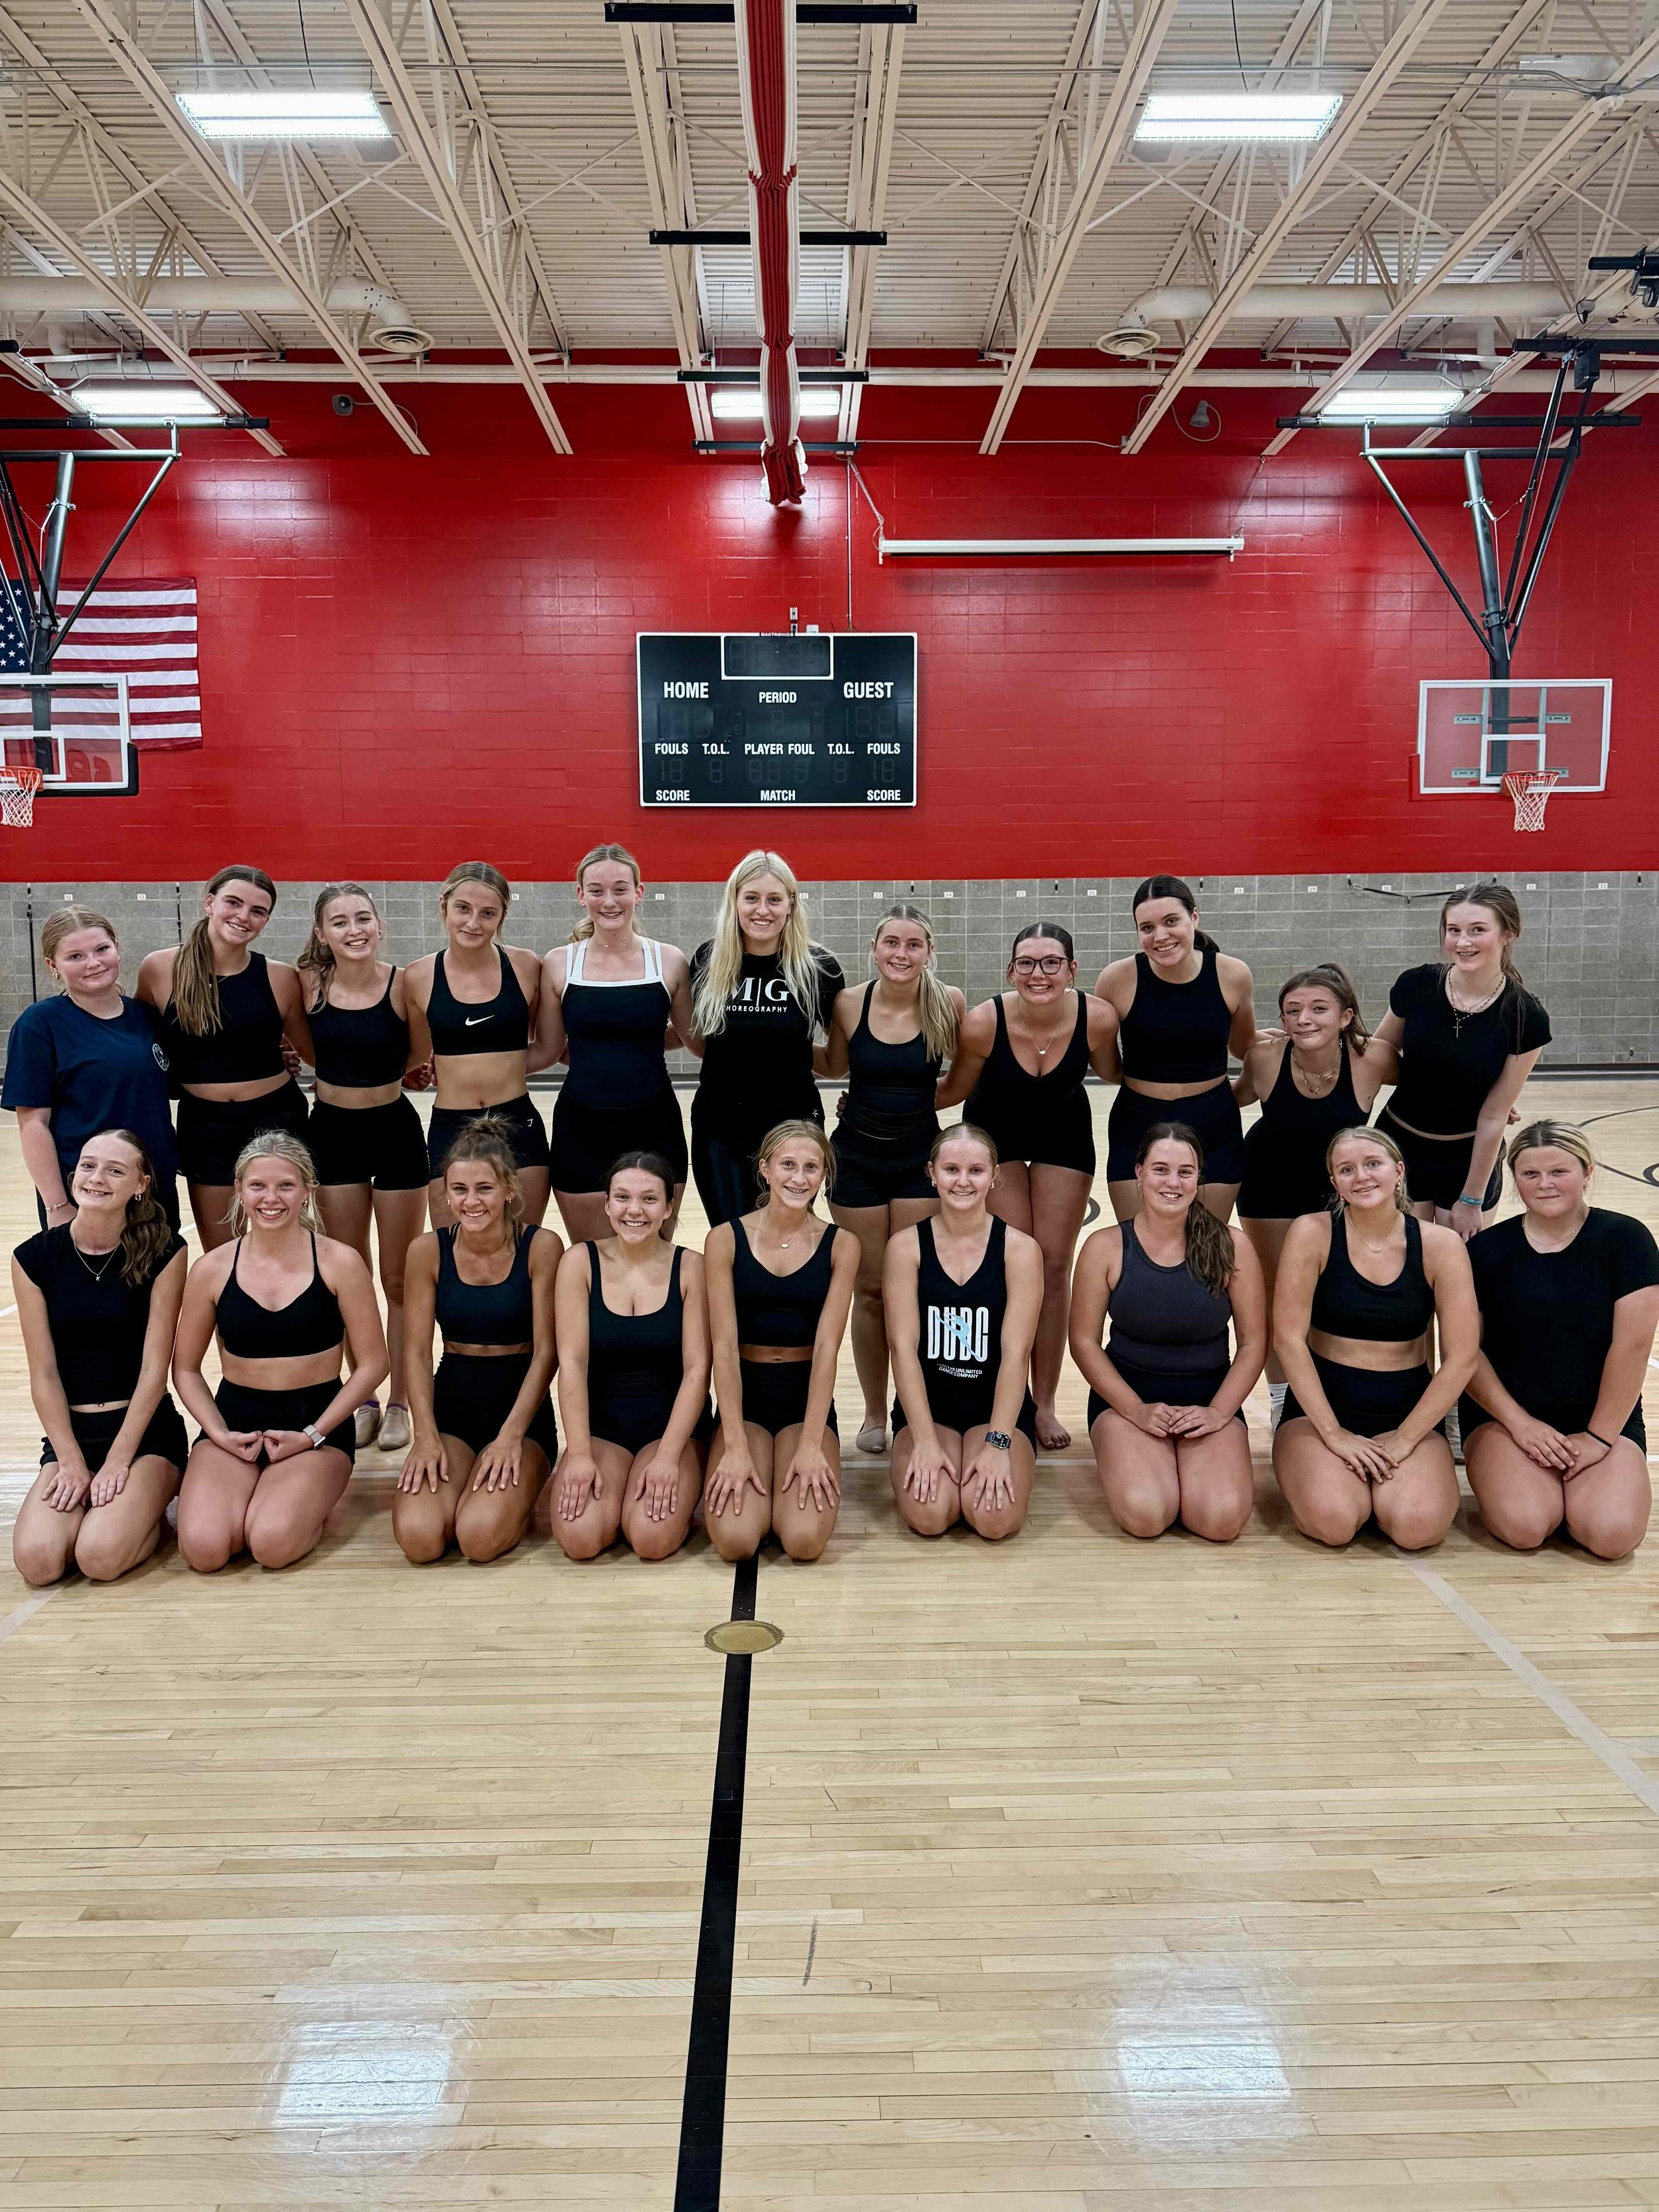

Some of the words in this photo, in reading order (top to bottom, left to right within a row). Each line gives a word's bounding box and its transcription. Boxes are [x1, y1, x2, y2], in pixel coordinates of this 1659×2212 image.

[664, 681, 709, 699] HOME
[843, 682, 895, 699] GUEST
[758, 692, 797, 703] PERIOD
[654, 743, 689, 755] FOULS
[702, 743, 730, 755] T.O.L.
[744, 743, 784, 755] PLAYER
[788, 743, 816, 755] FOUL
[827, 743, 855, 755] T.O.L.
[867, 743, 901, 755] FOULS
[656, 789, 690, 801] SCORE
[760, 789, 796, 801] MATCH
[867, 789, 901, 801] SCORE
[938, 1366, 954, 1376] DANCE
